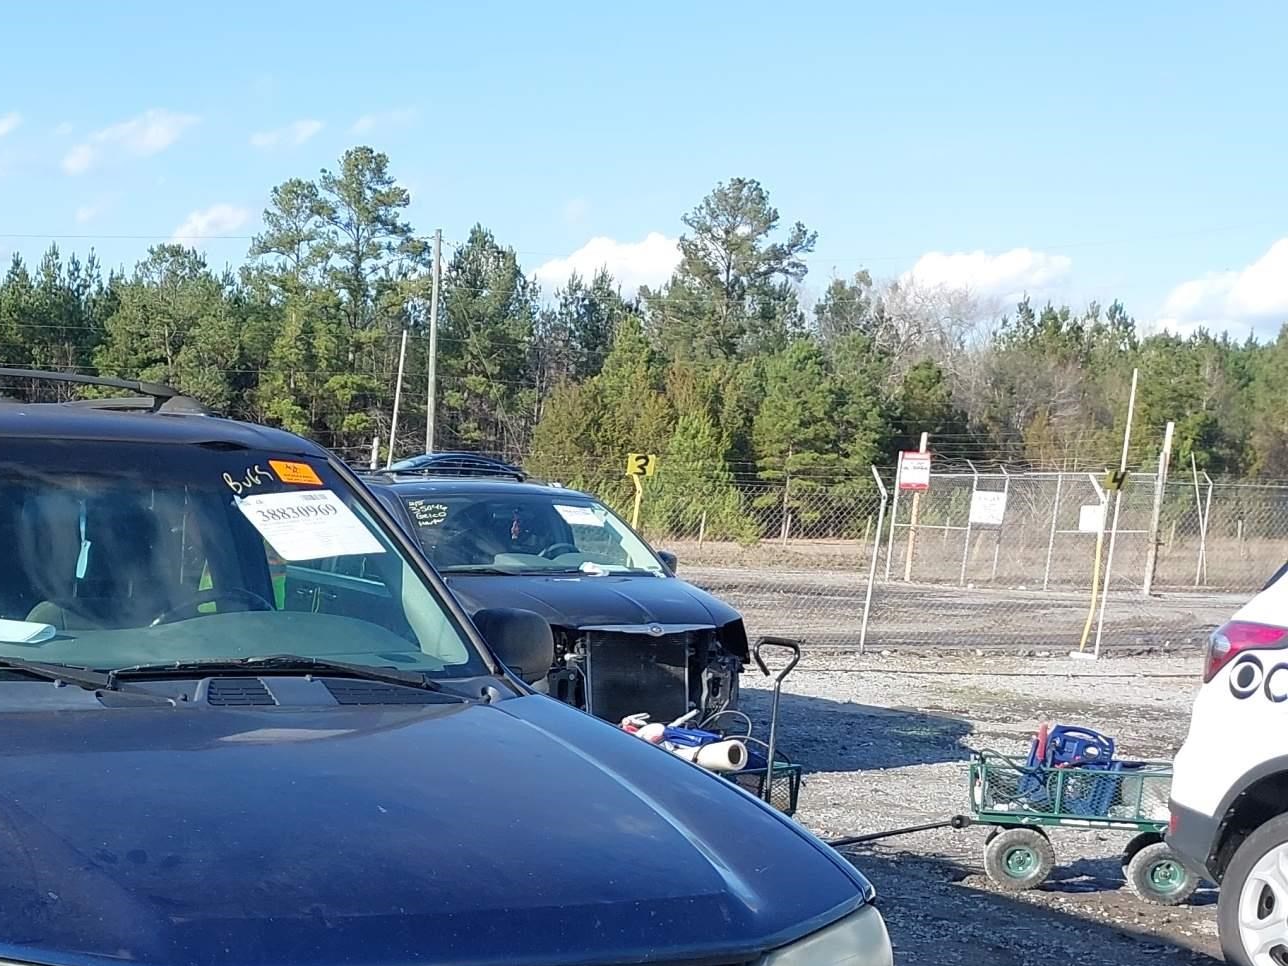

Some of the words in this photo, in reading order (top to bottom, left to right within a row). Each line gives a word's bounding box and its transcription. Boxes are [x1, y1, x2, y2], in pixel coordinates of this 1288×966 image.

[633, 455, 650, 476] 3
[1112, 471, 1127, 490] 4
[256, 503, 338, 522] 38830969
